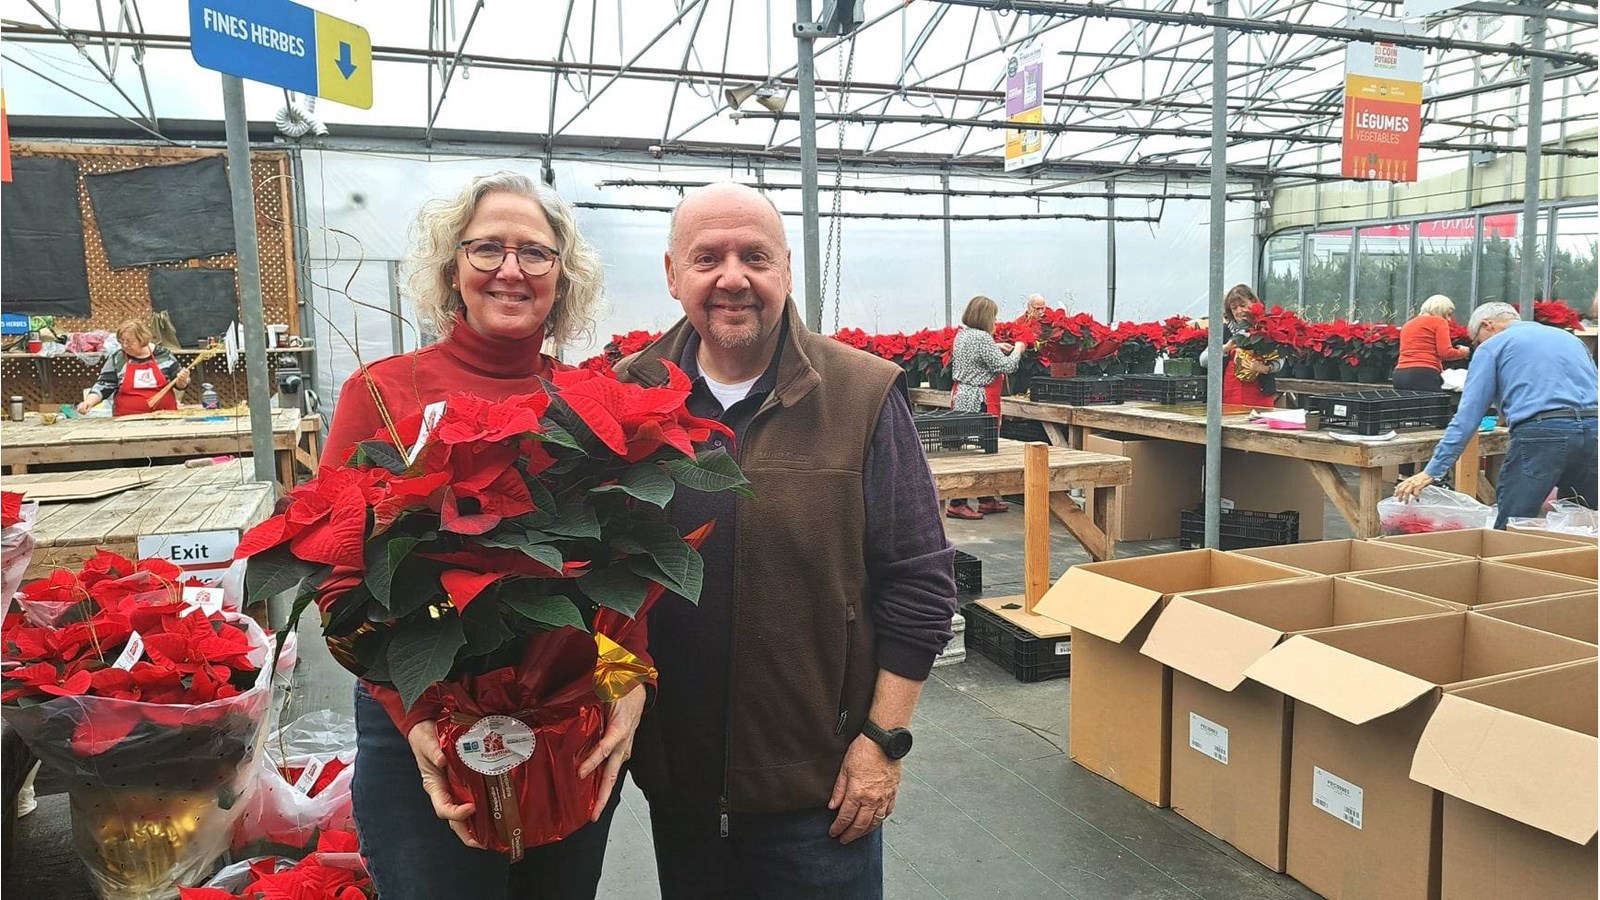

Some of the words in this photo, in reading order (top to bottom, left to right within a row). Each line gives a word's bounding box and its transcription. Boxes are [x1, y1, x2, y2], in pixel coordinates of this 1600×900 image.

[203, 7, 248, 40] FINES
[250, 22, 306, 57] HERBES
[1356, 109, 1409, 132] LÉGUMES
[1355, 130, 1400, 144] VEGETABLES
[171, 544, 209, 560] Exit
